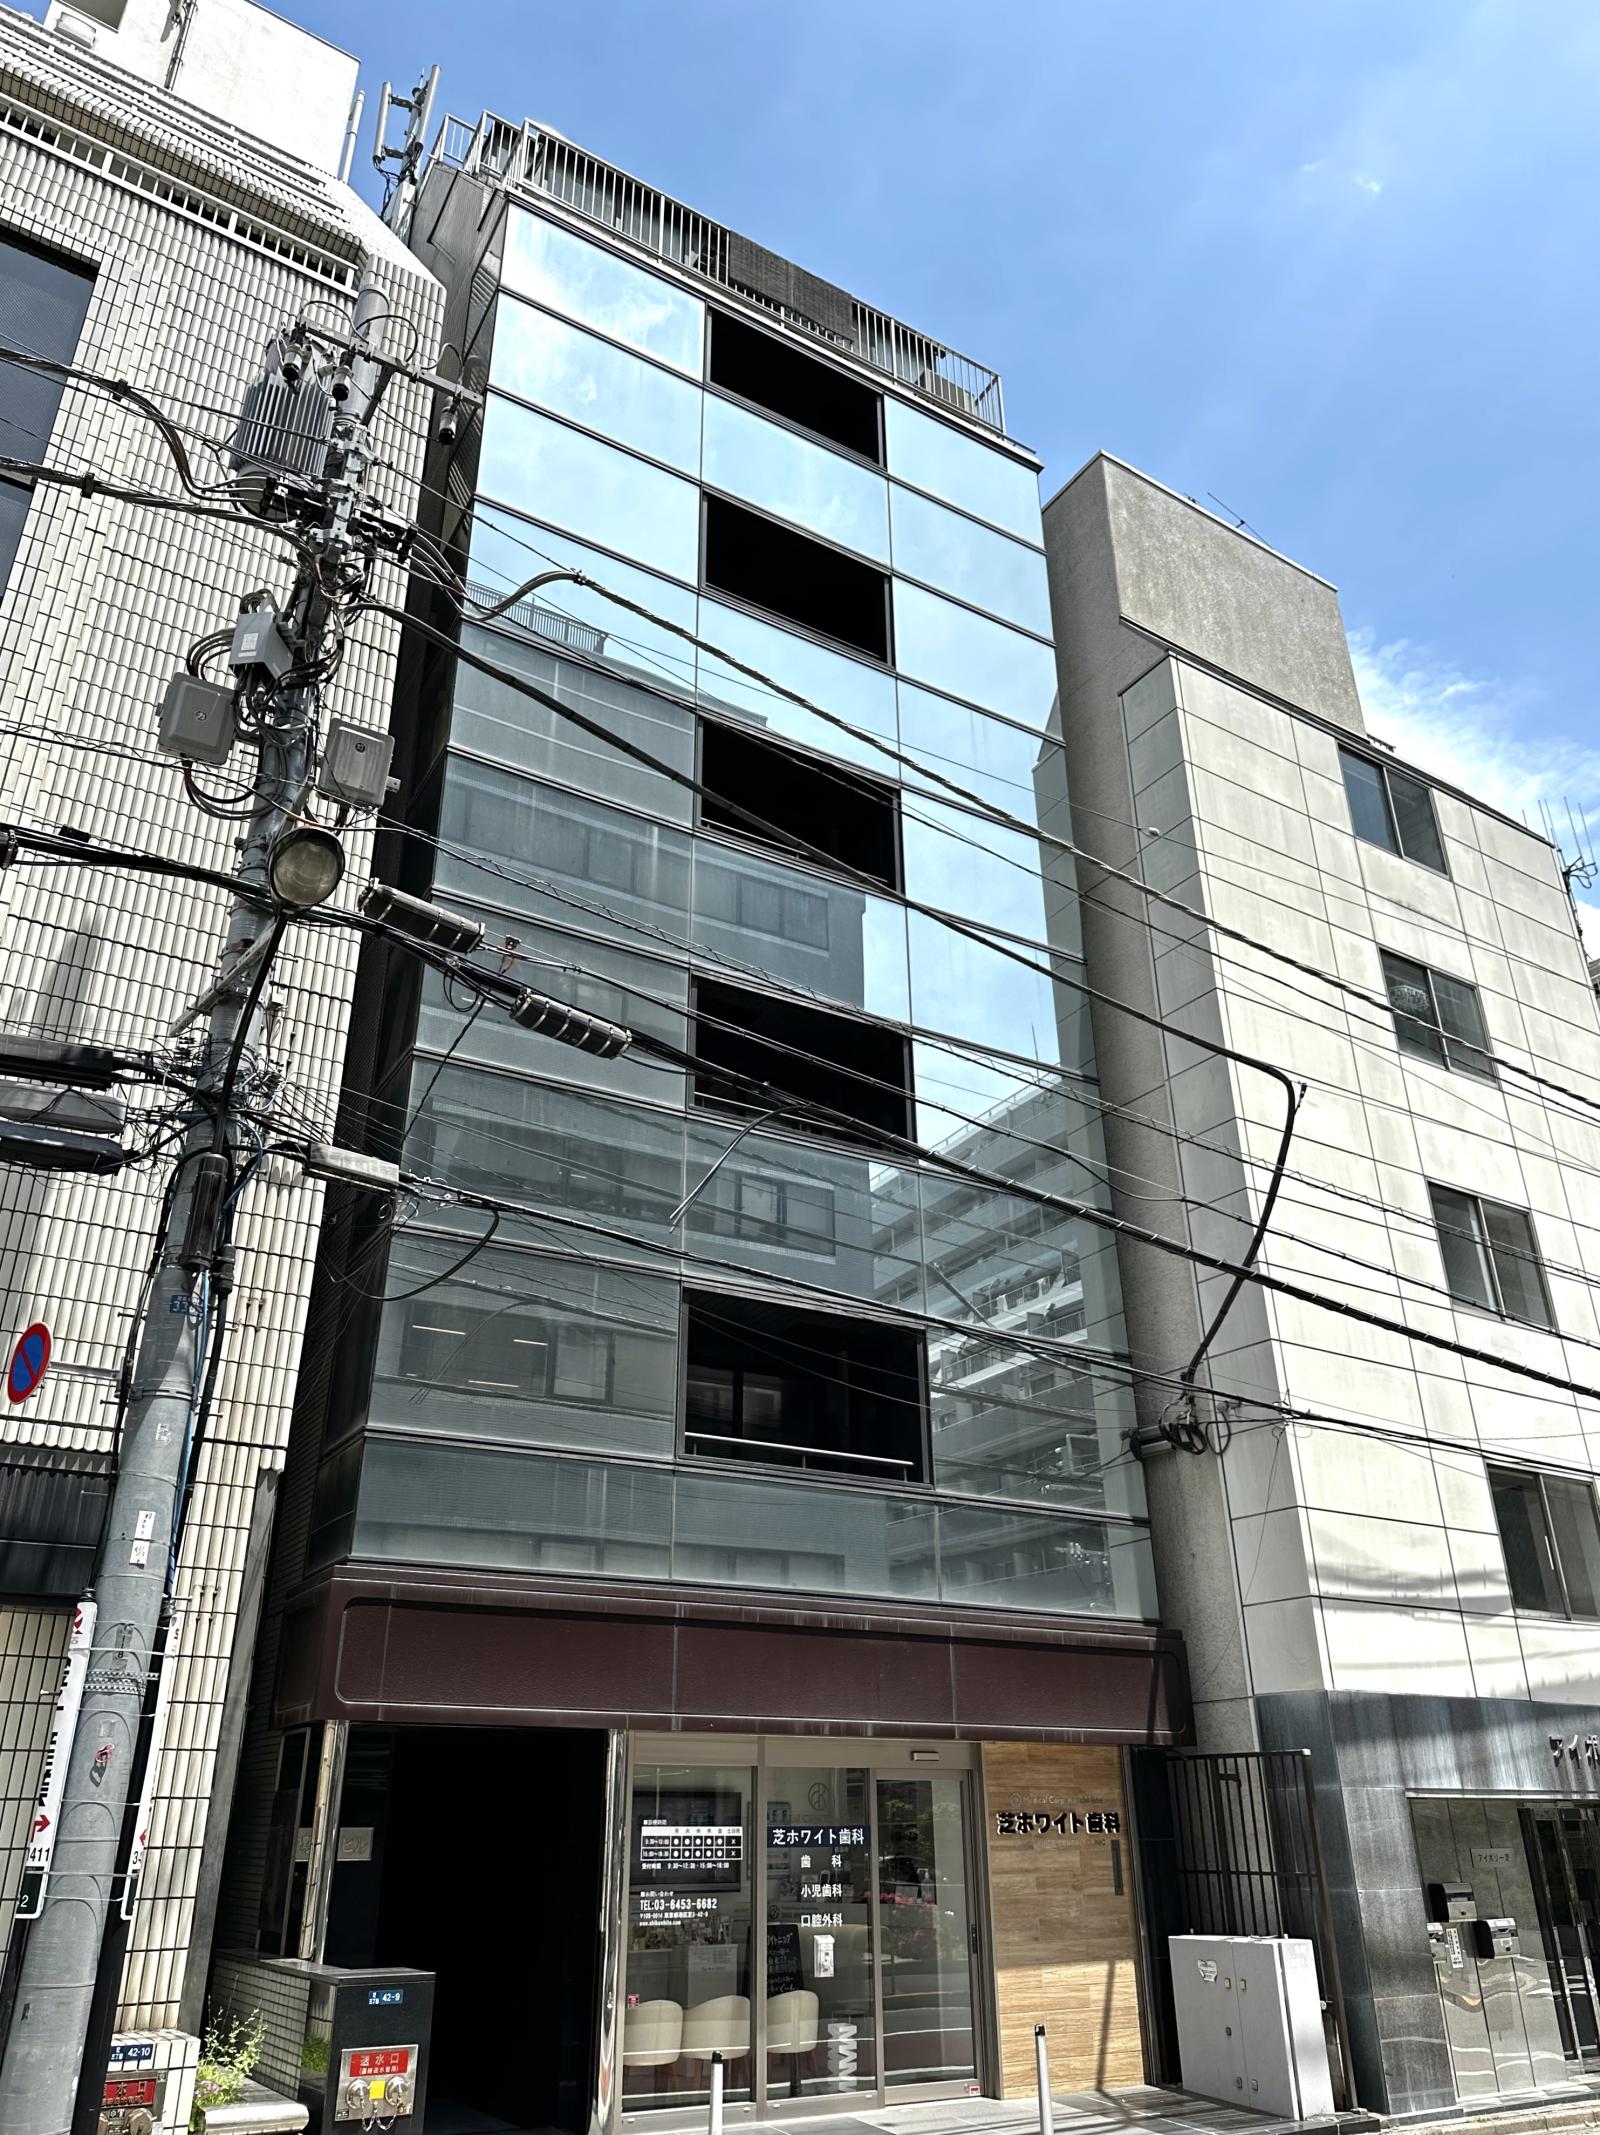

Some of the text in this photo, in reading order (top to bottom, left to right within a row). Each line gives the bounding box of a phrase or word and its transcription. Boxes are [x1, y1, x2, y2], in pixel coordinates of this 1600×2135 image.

[996, 1812, 1120, 1835] 芝ホワイト歯科
[772, 1828, 865, 1845] 芝ホワイト歯科
[800, 1883, 842, 1898] 小児歯科
[639, 1897, 718, 1911] TEL:03-6453-6682
[800, 1912, 843, 1928] 口腔外科
[382, 1992, 401, 2003] 42-9
[127, 2047, 151, 2057] 42-10
[360, 2053, 400, 2067] 送水口
